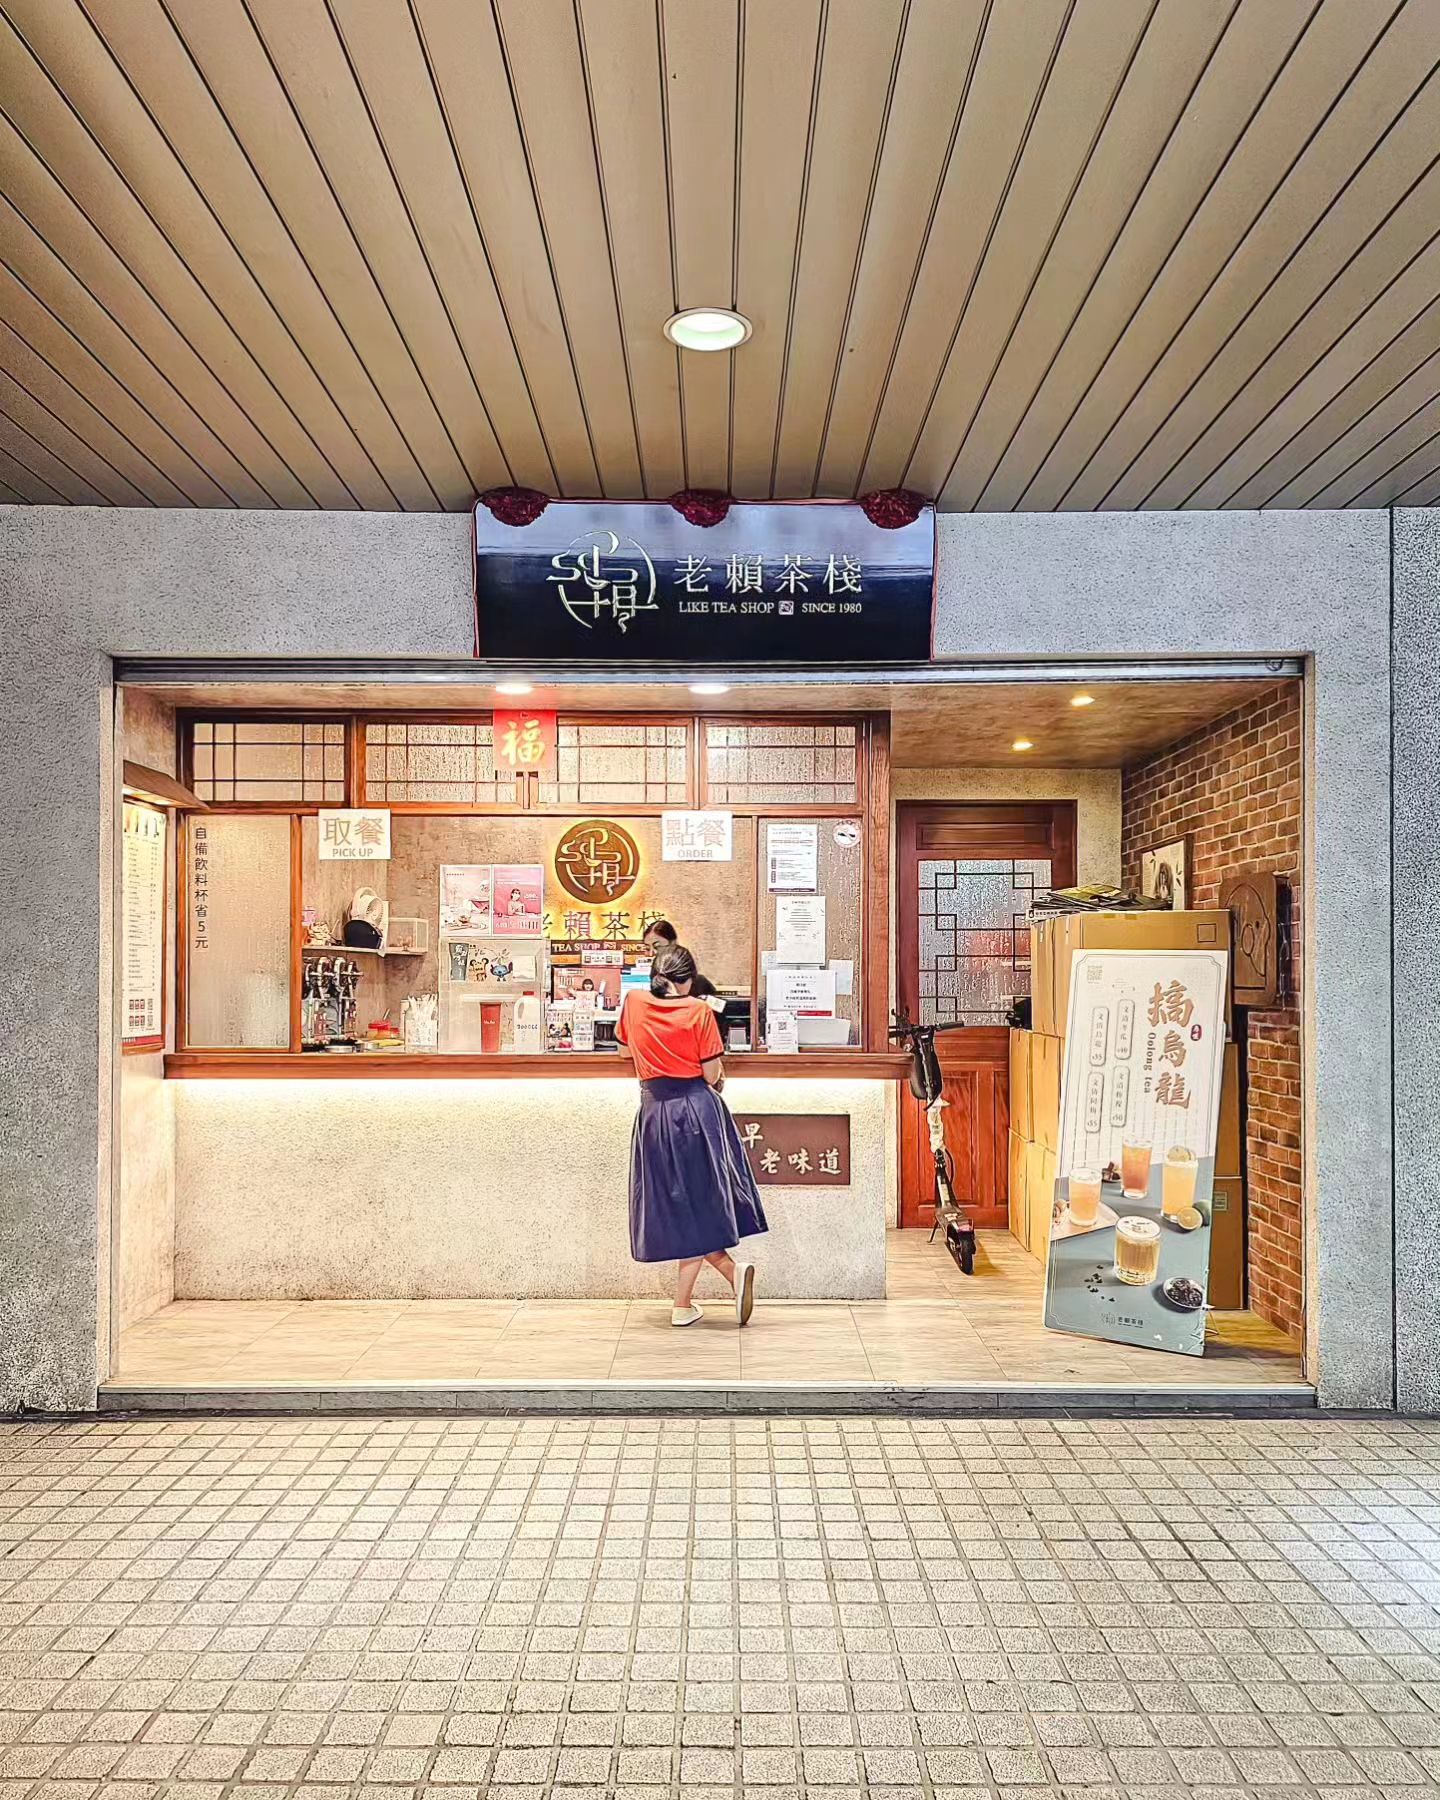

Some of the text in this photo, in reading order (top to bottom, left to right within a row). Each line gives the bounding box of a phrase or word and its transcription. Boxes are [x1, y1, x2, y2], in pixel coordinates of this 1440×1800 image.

[673, 553, 862, 595] 老賴茶棧
[679, 601, 710, 613] LIKE
[711, 601, 737, 613] TEA
[740, 601, 775, 613] SHOP
[801, 601, 836, 613] SINCE
[838, 601, 862, 613] 1980
[501, 719, 546, 766] 福
[322, 816, 385, 846] 取餐
[665, 818, 726, 847] 點餐
[332, 848, 374, 857] PICK UP
[677, 849, 713, 858] ORDER
[194, 827, 209, 949] 自備飲料杯省5元
[552, 943, 573, 952] TEA
[1147, 979, 1194, 1110] 搞烏龍
[1143, 1032, 1157, 1094] Oolong tea
[741, 1122, 764, 1149] 早
[759, 1147, 842, 1175] 老味道
